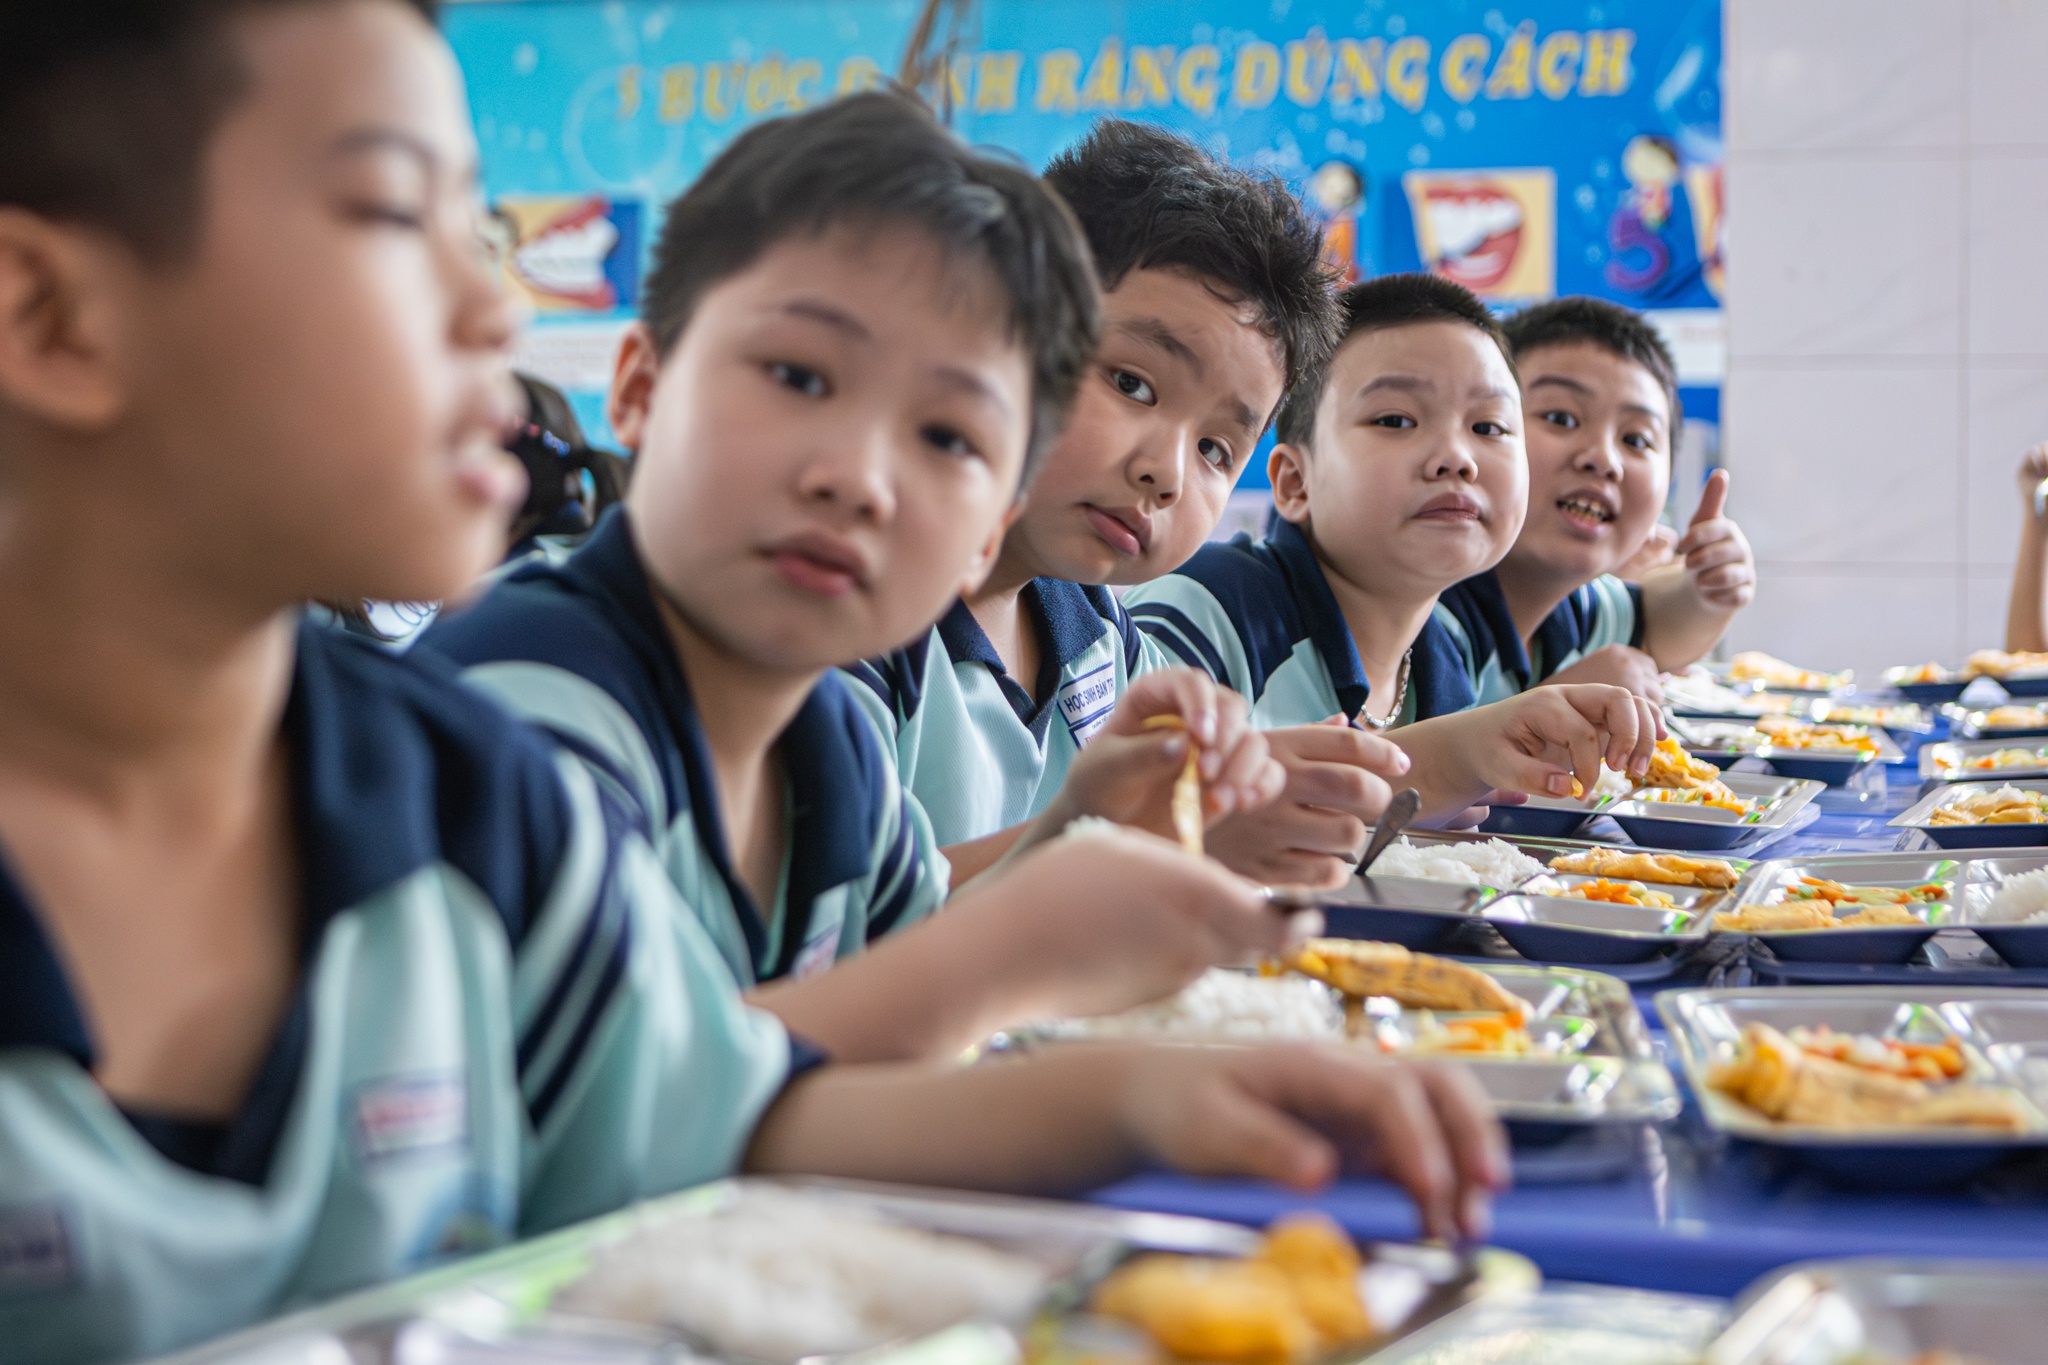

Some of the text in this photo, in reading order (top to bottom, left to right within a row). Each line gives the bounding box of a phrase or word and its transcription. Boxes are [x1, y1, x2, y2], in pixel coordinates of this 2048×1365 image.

[1439, 18, 1637, 103] CÁCH
[1604, 206, 1671, 292] 5
[1064, 692, 1085, 712] HỌC
[1083, 686, 1098, 705] SINH
[1106, 677, 1114, 692] TR
